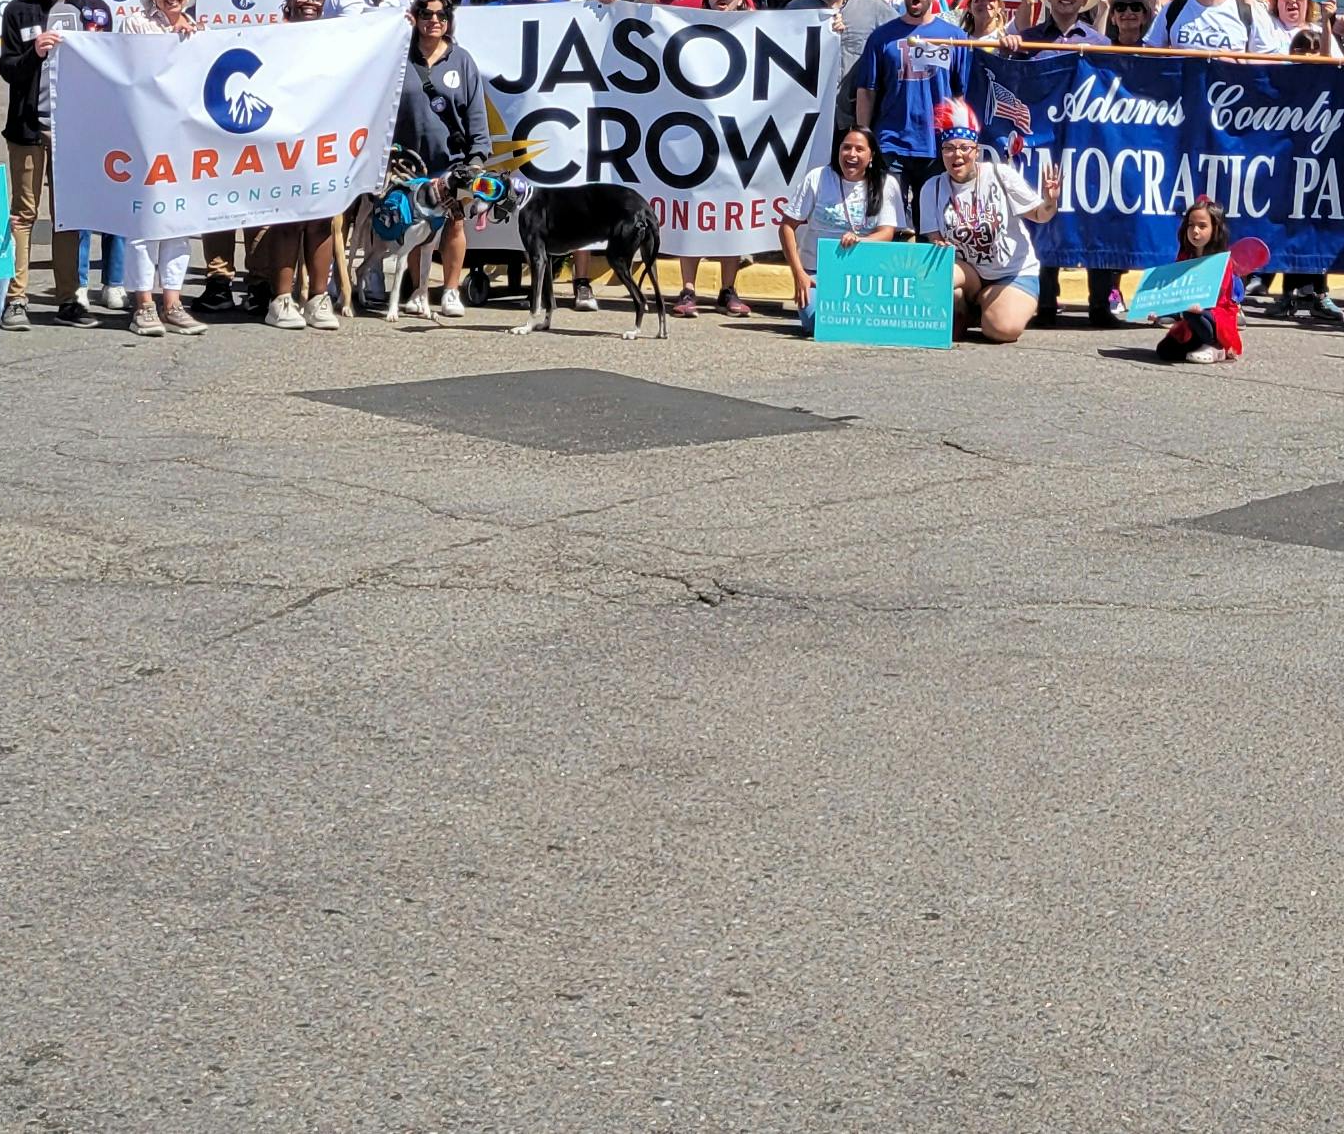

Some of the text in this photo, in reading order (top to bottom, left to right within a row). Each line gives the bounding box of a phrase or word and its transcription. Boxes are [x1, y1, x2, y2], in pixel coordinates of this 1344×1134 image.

[1177, 30, 1232, 50] BACA
[489, 18, 822, 101] JASON
[1048, 75, 1185, 128] Adams
[103, 127, 369, 186] CARAVEO
[511, 106, 821, 190] CROW
[133, 176, 350, 214] FOR CONGRESS
[649, 196, 808, 232] ONGRES
[844, 274, 916, 298] JULIE
[819, 300, 947, 319] DURAN MULLICA
[820, 315, 946, 330] COUNTY COMMISSIONER
